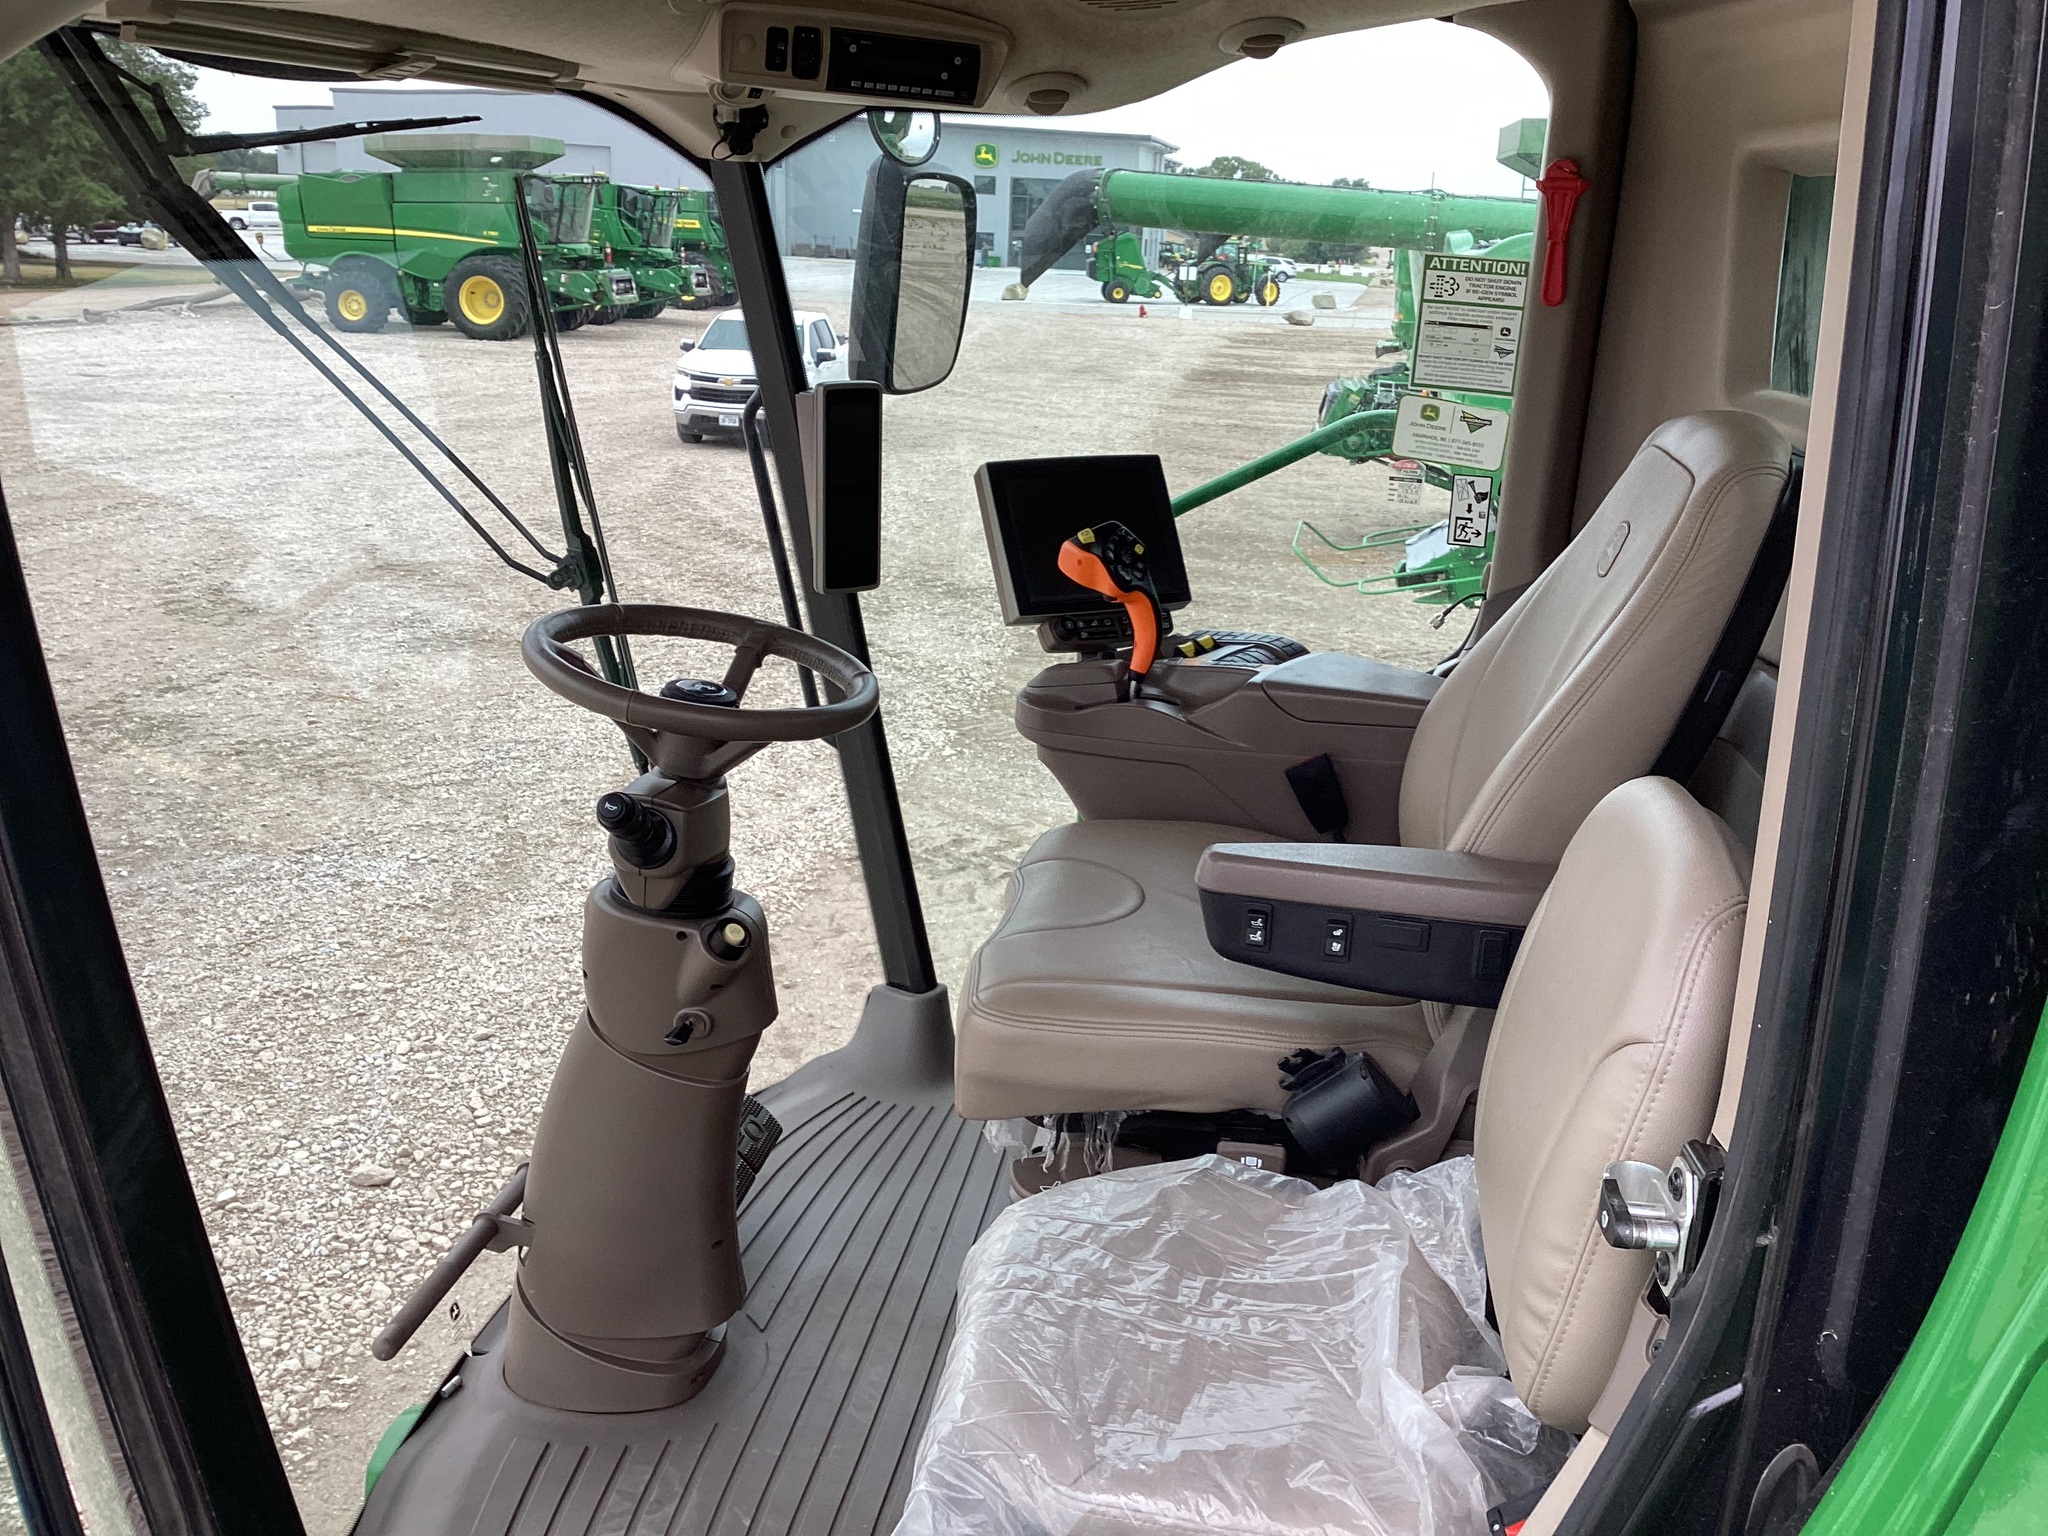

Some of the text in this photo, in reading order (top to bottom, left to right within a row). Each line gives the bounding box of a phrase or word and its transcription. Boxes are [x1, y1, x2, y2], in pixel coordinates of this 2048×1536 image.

[1011, 150, 1103, 166] JOHN DEERE
[1429, 257, 1526, 275] ATTENTION!
[1408, 421, 1447, 432] JOHN DEERE
